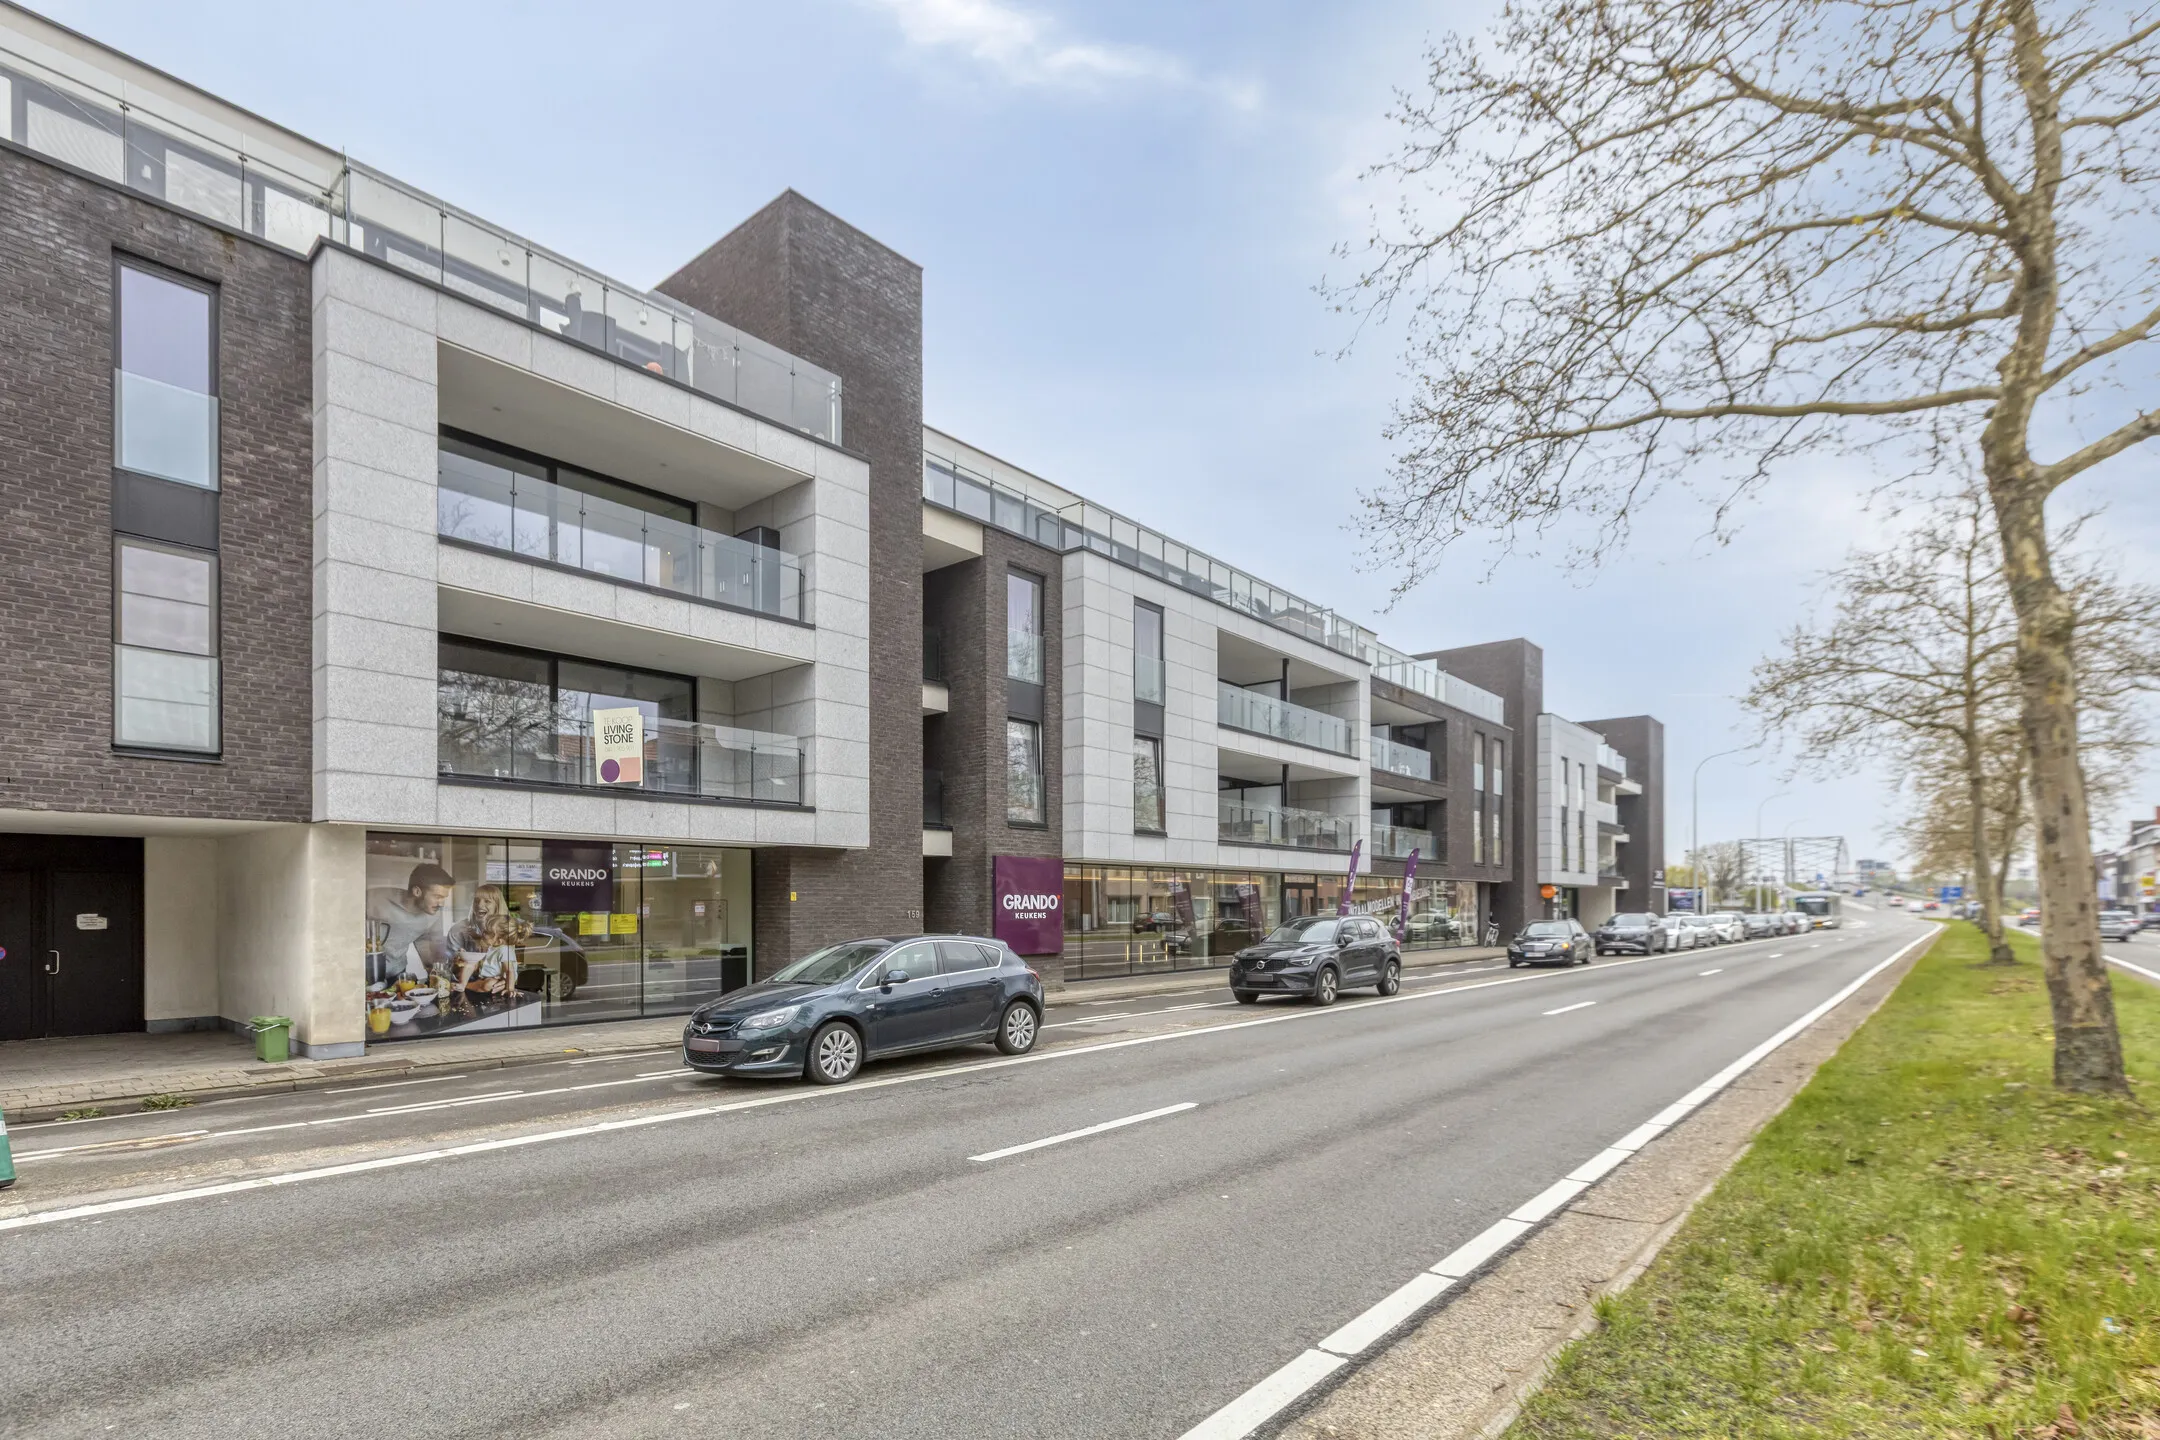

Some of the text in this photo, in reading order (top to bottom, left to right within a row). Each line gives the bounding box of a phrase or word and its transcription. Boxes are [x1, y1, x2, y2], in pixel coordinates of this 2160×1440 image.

[612, 716, 632, 724] KOOP
[603, 723, 634, 735] LIVING
[603, 733, 634, 745] STONE
[549, 868, 607, 880] GRANDO
[1002, 894, 1059, 910] GRANDO
[907, 910, 920, 919] 159
